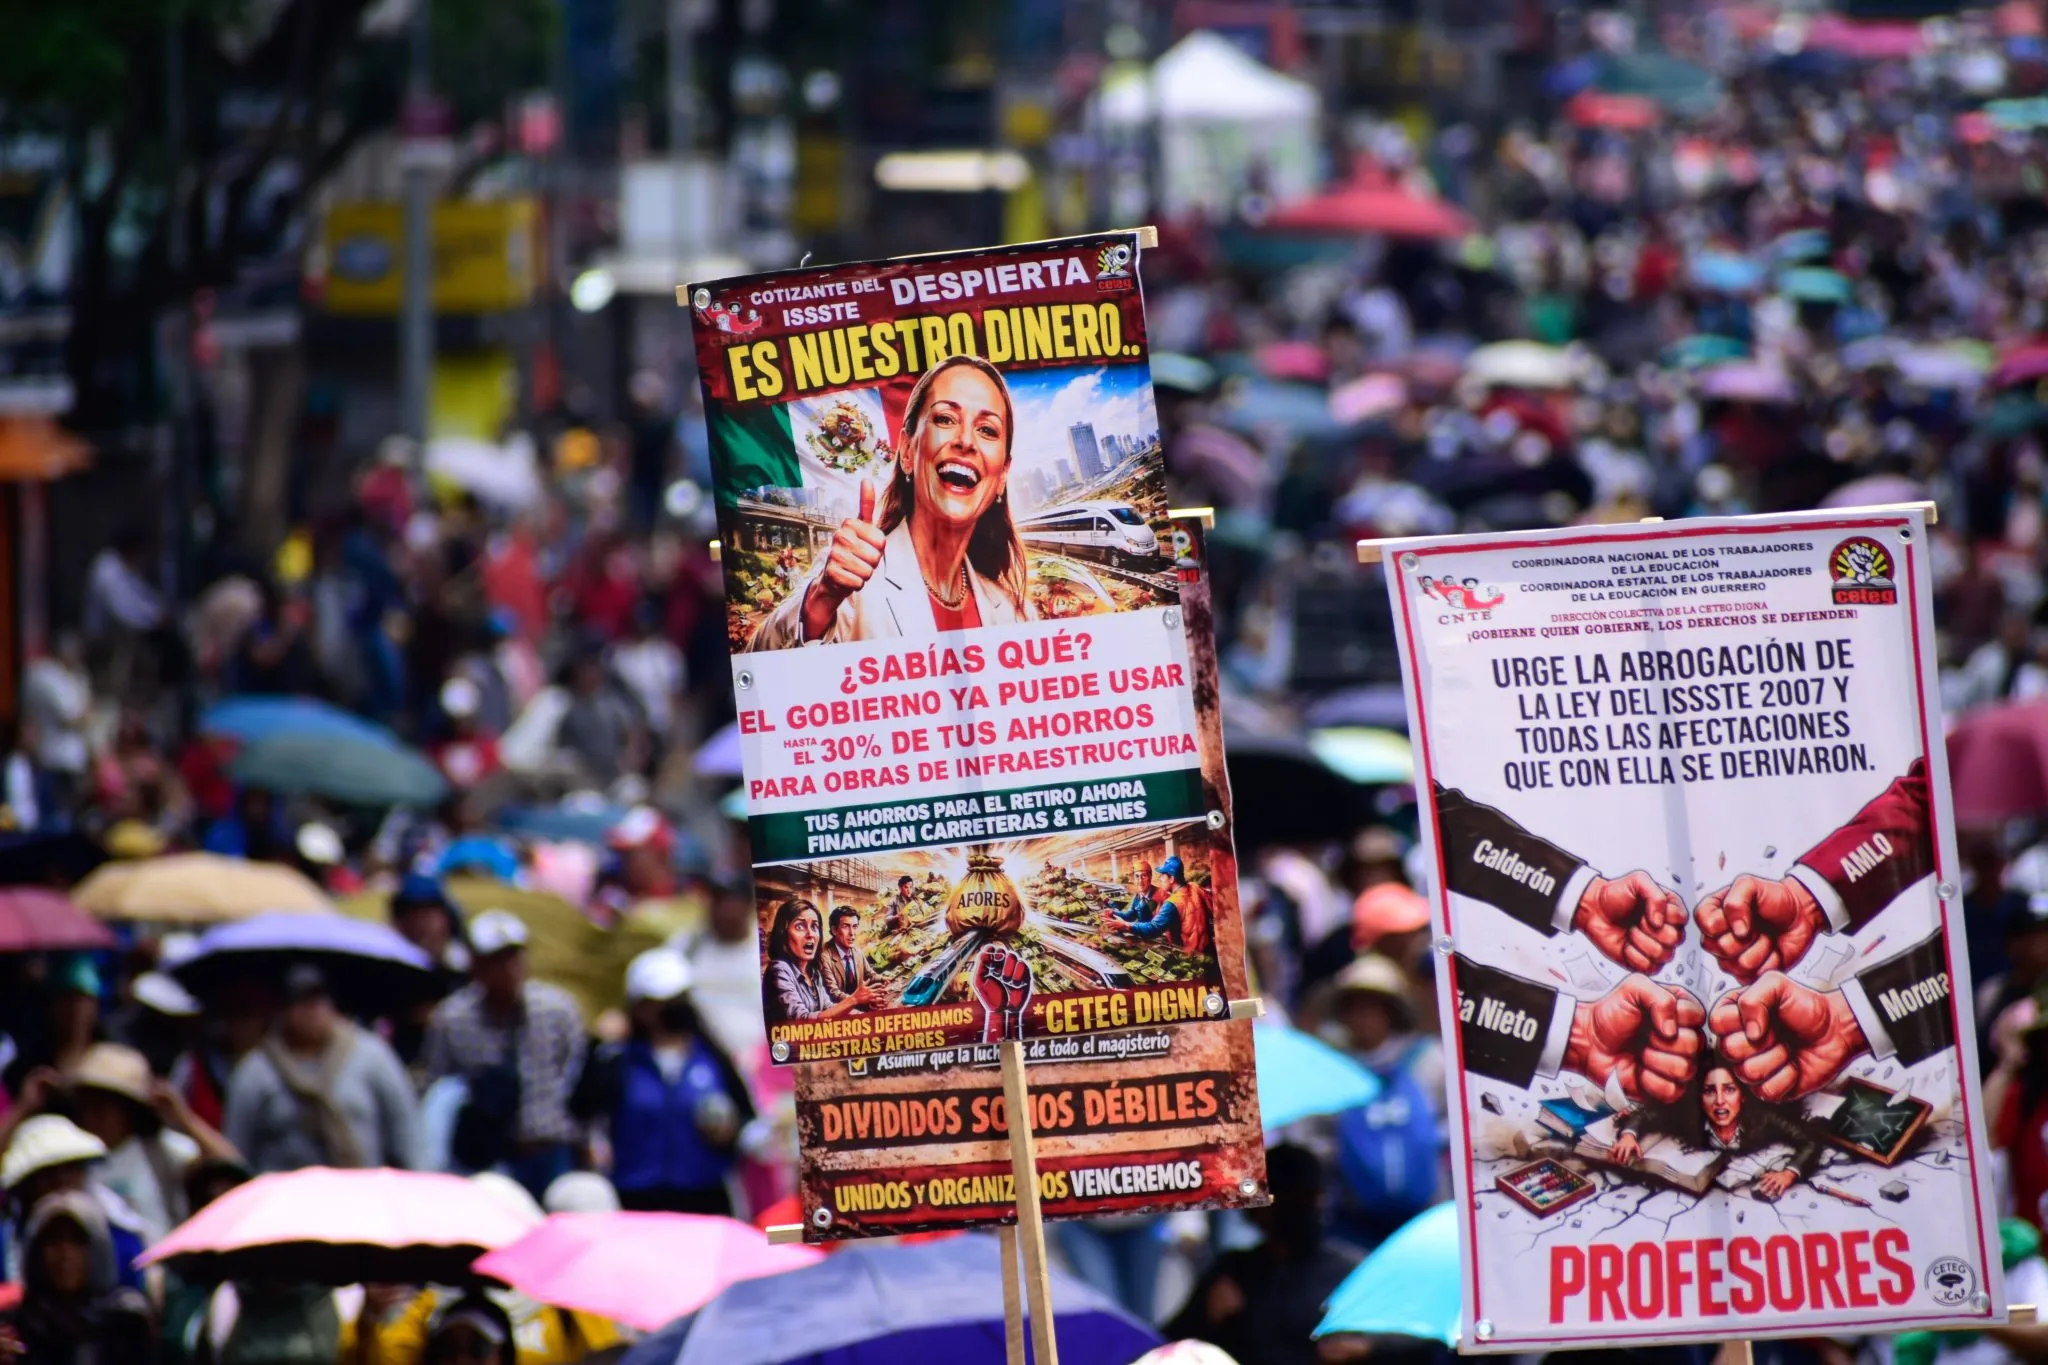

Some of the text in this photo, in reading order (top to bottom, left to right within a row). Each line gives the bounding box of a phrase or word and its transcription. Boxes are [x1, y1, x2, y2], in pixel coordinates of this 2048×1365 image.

[751, 278, 885, 305] COTIZANTE DEL
[891, 256, 1090, 305] DESPIERTA
[783, 301, 860, 327] ISSSTE
[727, 302, 1141, 401] ES NUESTRO DINERO..
[1512, 542, 1813, 569] COORDINADORA NACIONAL DE LOS TRABAJADORES
[1611, 560, 1719, 575] DE LA EDUCACIÓN
[1520, 567, 1812, 592] COORDINADORA ESTATAL DE LOS TRABAJADORES
[1571, 582, 1766, 602] DE LA EDUCACIÓN EN GUERRERO
[1835, 589, 1895, 605] ceteg
[1438, 610, 1493, 625] CNTE
[1541, 626, 1579, 638] QUIEN
[1585, 621, 1654, 634] GOBIERNE,
[1658, 619, 1683, 631] LOS
[1688, 615, 1757, 628] DERECHOS
[1762, 613, 1777, 623] SE
[1782, 609, 1858, 623] DEFIENDEN!
[1551, 601, 1768, 622] DIRECCIÓN COLECTIVA DE LA CETEG DIGNA
[840, 629, 1093, 694] ¿SABÍAS QUÉ?
[1492, 637, 1854, 688] URGE LA ABROGACIÓN DE
[739, 663, 1184, 735] EL GOBIERNO YA PUEDE USAR
[1519, 676, 1850, 721] LA LEY DEL ISSSTE 2007 Y
[784, 703, 1155, 763] HASTA 30% DE TUS AHORROS
[1516, 711, 1851, 754] TODAS LAS AFECTACIONES
[751, 733, 1197, 800] PARA OBRAS DE INFRAESTRUCTURA
[794, 751, 815, 765] EL
[1504, 744, 1875, 791] QUE CON ELLA SE DERIVARON.
[804, 780, 1146, 832] TUS AHORROS PARA EL RETIRO AHORA
[807, 801, 1147, 854] FINANCIAN CARRETERAS & TRENES
[1472, 840, 1556, 896] Calderón
[1840, 832, 1894, 883] AMLO
[958, 891, 1010, 909] AFORES
[771, 1007, 973, 1043] COMPAÑEROS DEFENDAMOS
[1476, 996, 1538, 1042] Nieto
[799, 1030, 945, 1060] NUESTRAS AFORES
[877, 1033, 1170, 1070] Asumir que la luchs de todo el magisterio
[822, 1096, 962, 1141] DIVIDIDOS
[1083, 1079, 1217, 1126] DÉBILES
[835, 1180, 912, 1213] UNIDOS
[930, 1171, 1068, 1207] ORGANIZOS
[1070, 1161, 1202, 1197] VENCEREMOS
[1549, 1228, 1915, 1324] PROFESORES
